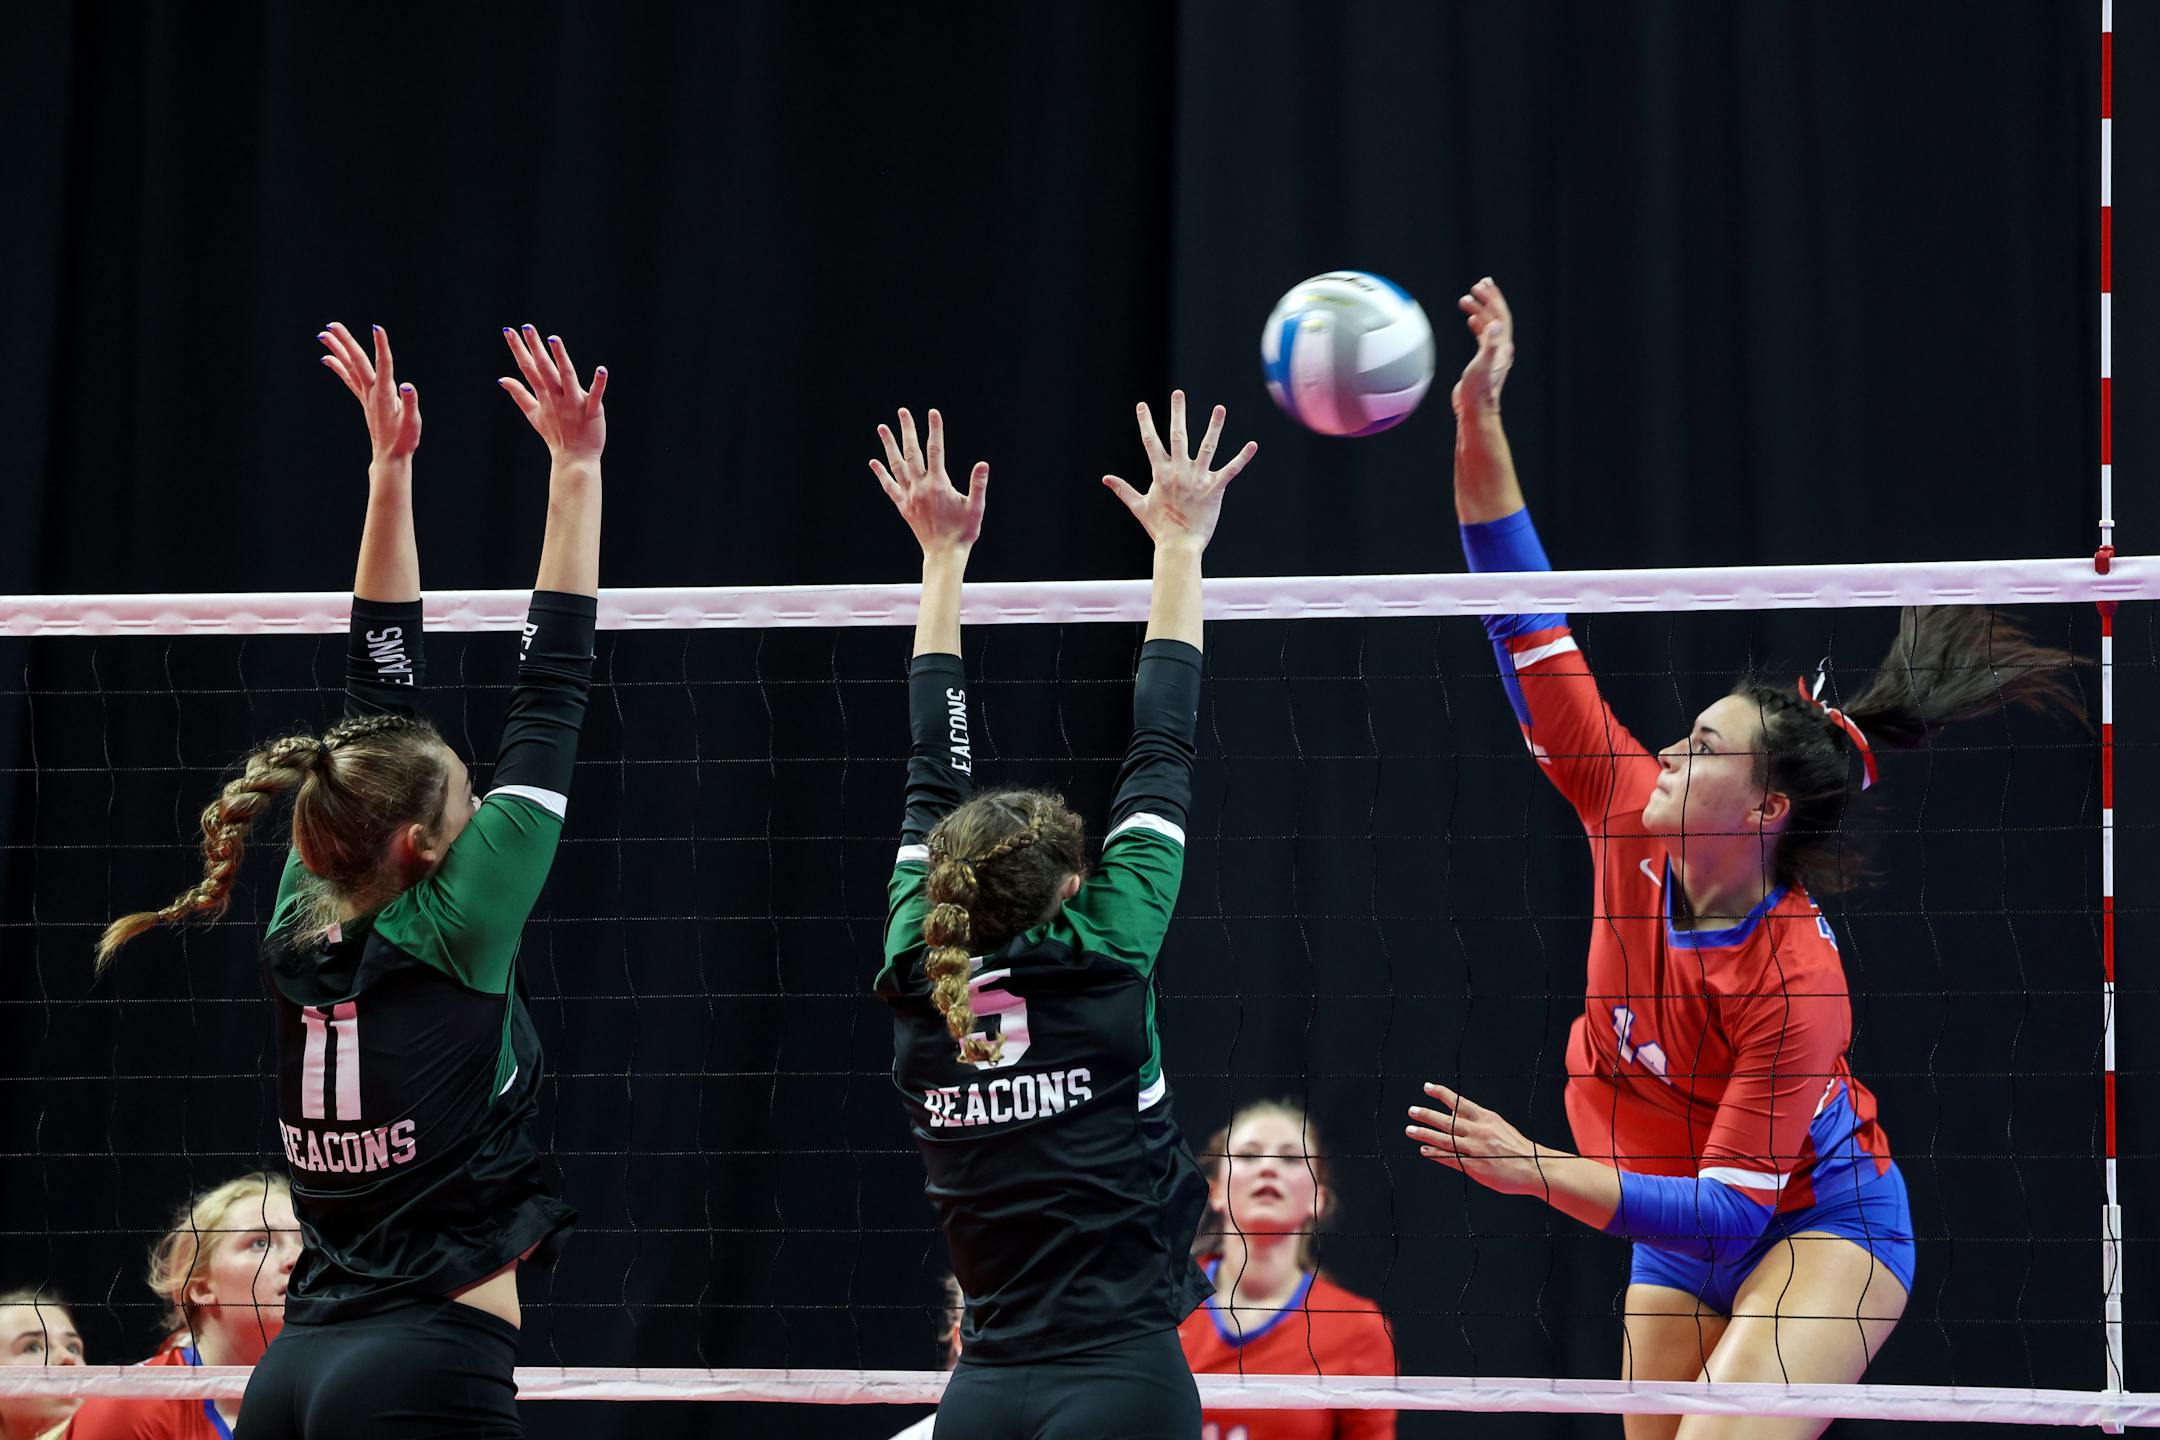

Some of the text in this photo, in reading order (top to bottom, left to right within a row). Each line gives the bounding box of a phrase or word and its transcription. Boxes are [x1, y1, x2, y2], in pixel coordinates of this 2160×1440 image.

[946, 688, 971, 776] EACONS
[958, 957, 1031, 1070] 5
[301, 1001, 361, 1120] 11
[924, 1068, 1092, 1127] BEACONS
[279, 1118, 416, 1173] BEACONS
